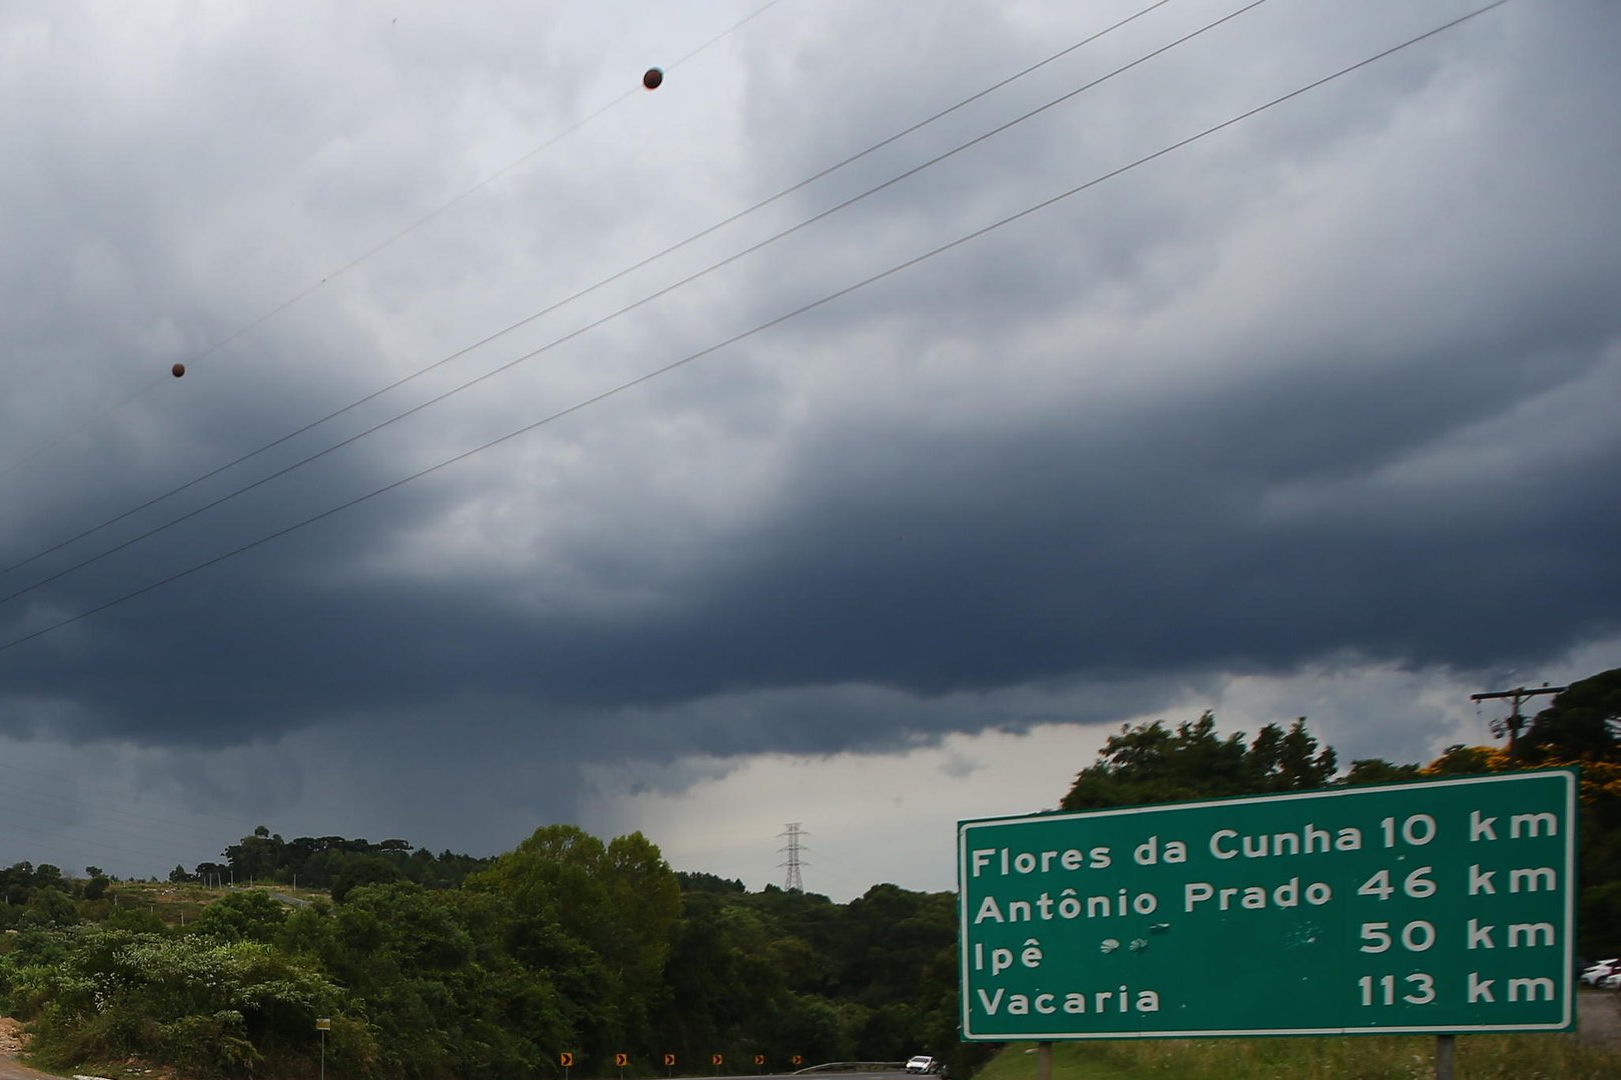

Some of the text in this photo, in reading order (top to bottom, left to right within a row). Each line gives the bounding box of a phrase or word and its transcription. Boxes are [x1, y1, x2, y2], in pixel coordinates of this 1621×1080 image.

[1382, 811, 1556, 847] 10 km
[972, 824, 1361, 877] Flores da Cunha
[1358, 865, 1555, 900] 46 km
[974, 877, 1331, 924] Antônio Prado
[1361, 919, 1554, 953] 50 km
[976, 939, 1042, 976] Ipê
[978, 985, 1158, 1015] Vacaria
[1360, 973, 1554, 1006] 113 km
